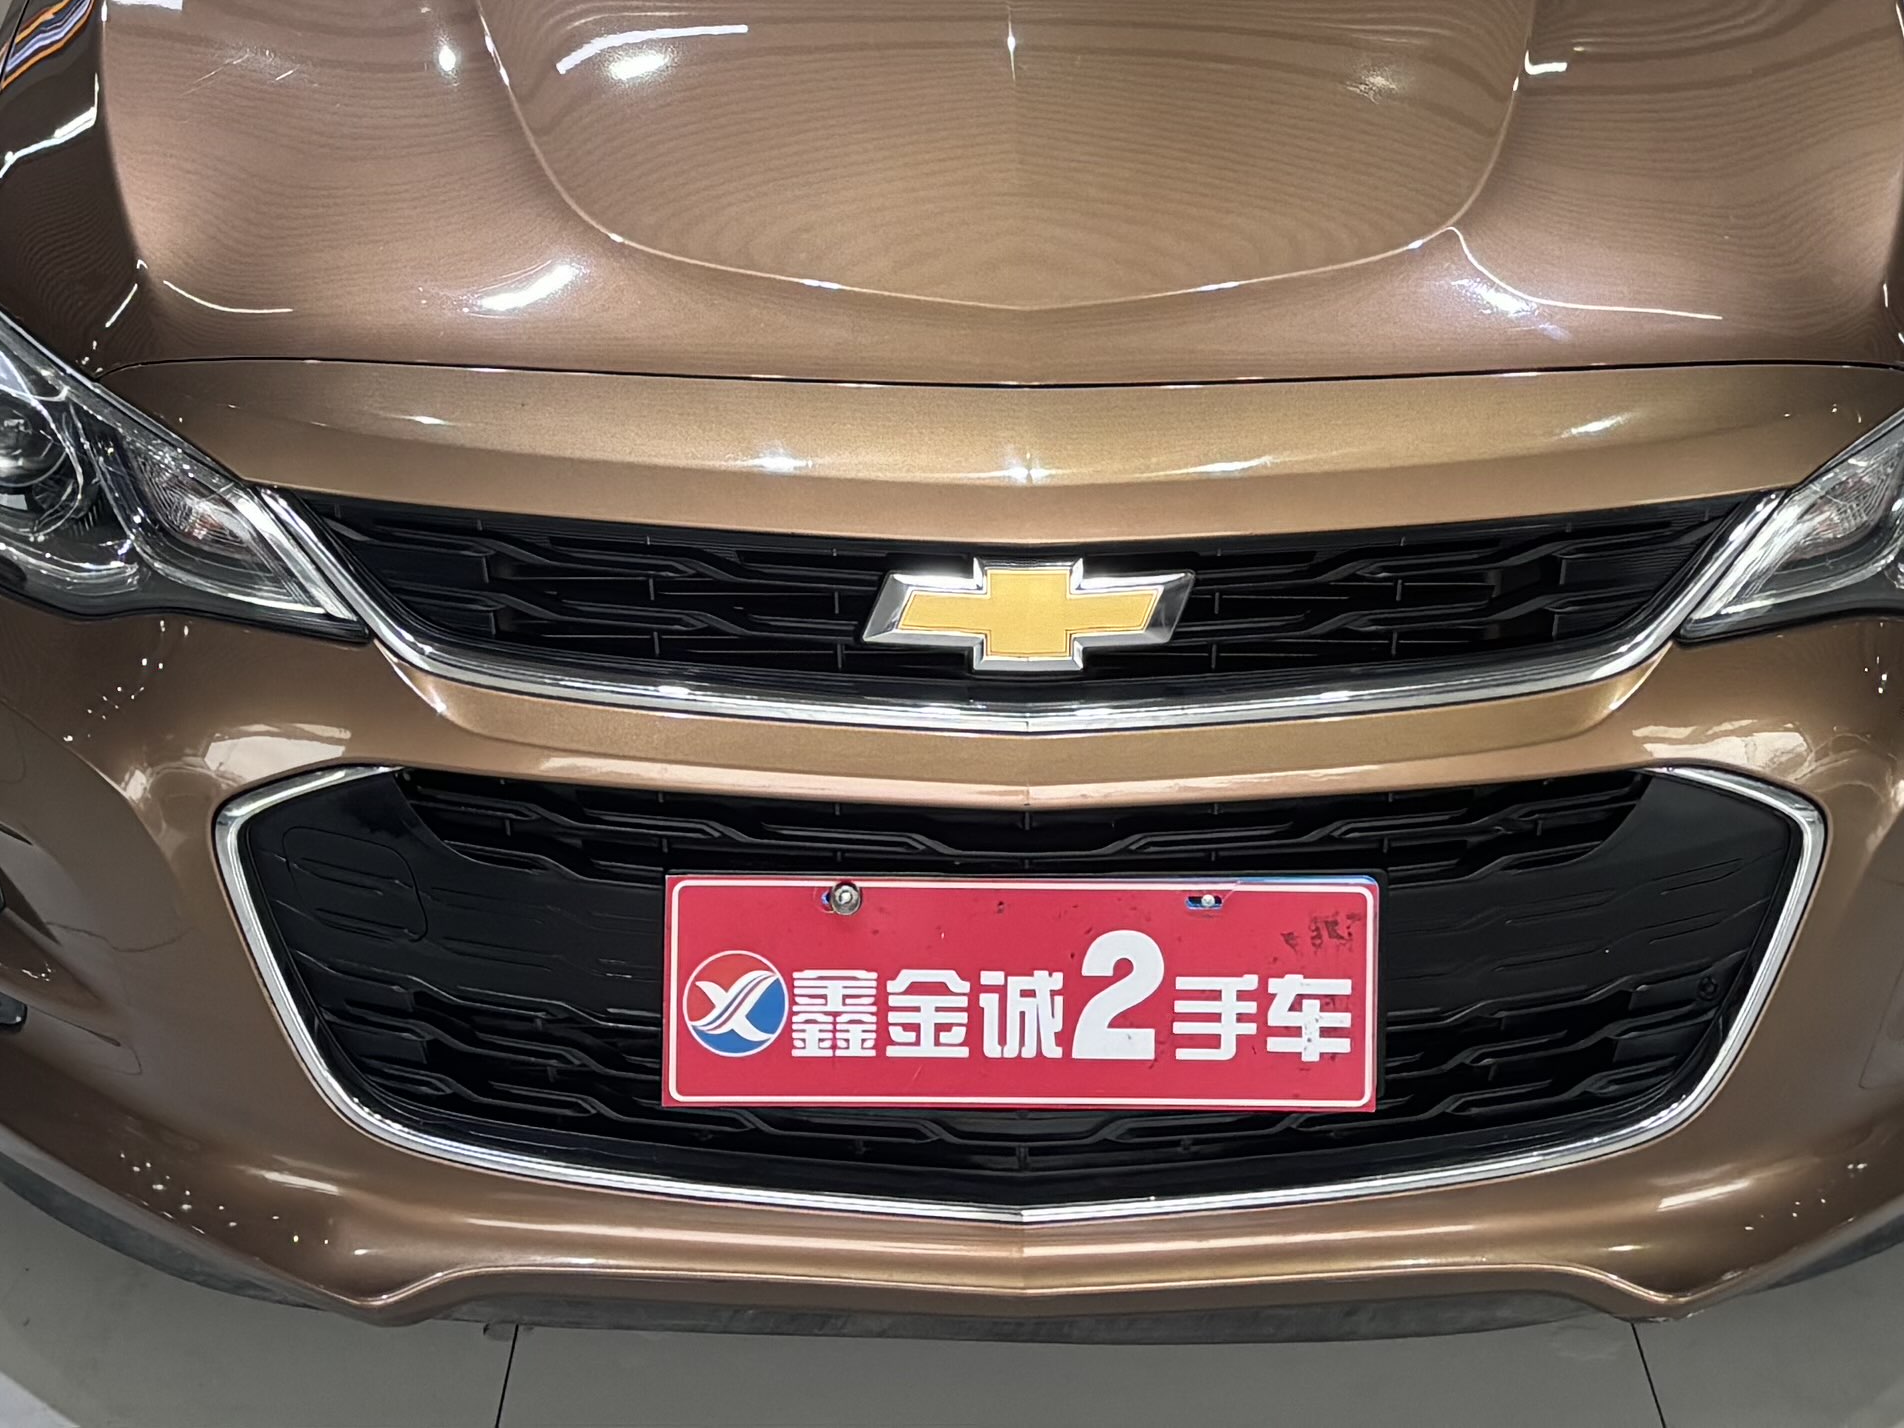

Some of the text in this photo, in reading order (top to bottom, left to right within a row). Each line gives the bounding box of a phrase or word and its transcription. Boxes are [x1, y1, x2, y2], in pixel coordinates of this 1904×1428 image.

[791, 928, 1354, 1063] 鑫金诚2手车
